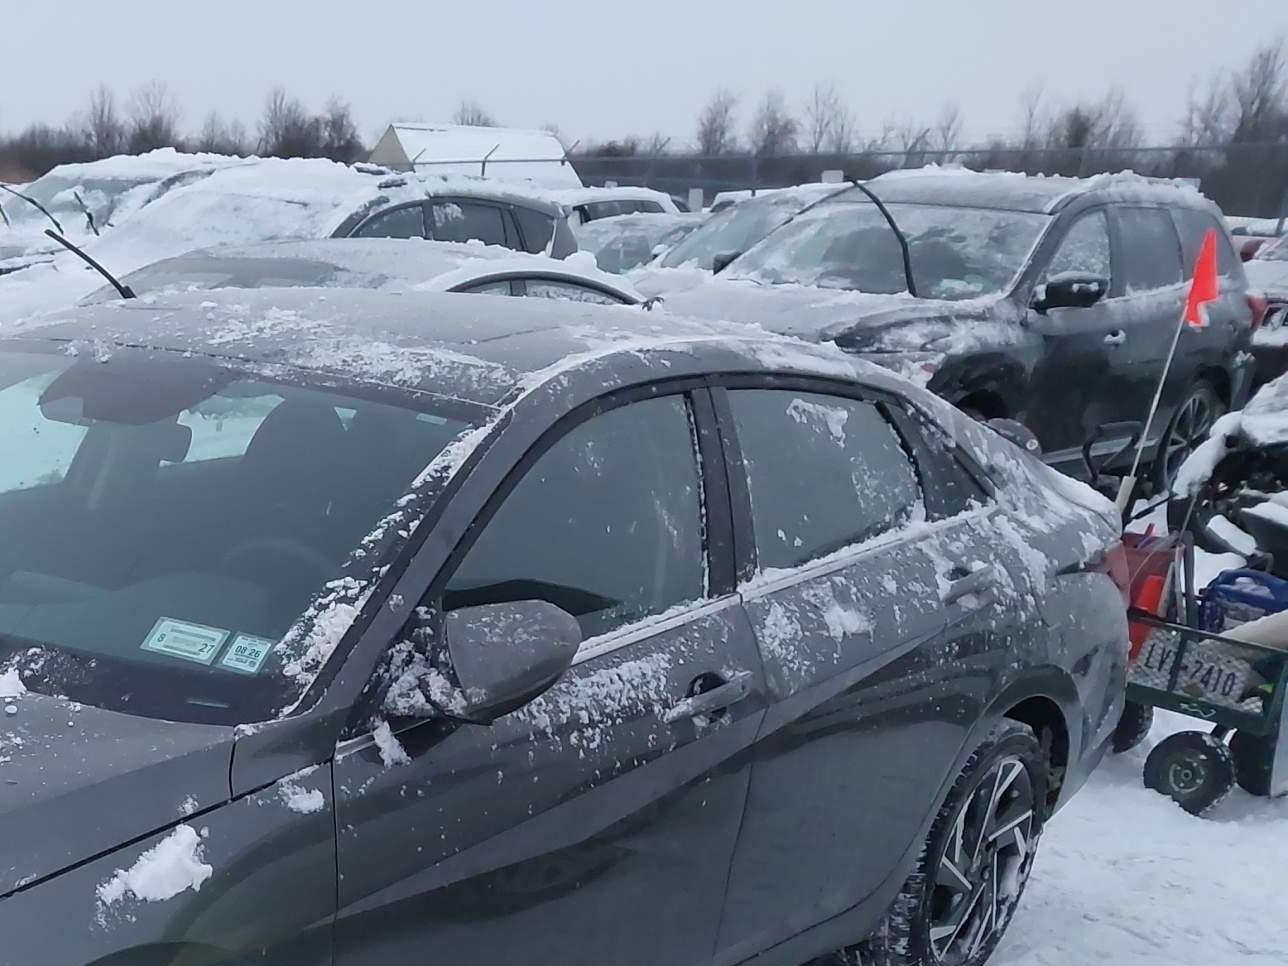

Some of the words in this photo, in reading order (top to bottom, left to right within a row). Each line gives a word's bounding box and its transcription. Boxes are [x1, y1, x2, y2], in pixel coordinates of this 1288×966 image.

[198, 643, 216, 653] 27
[234, 645, 248, 654] 08
[248, 648, 262, 658] 26
